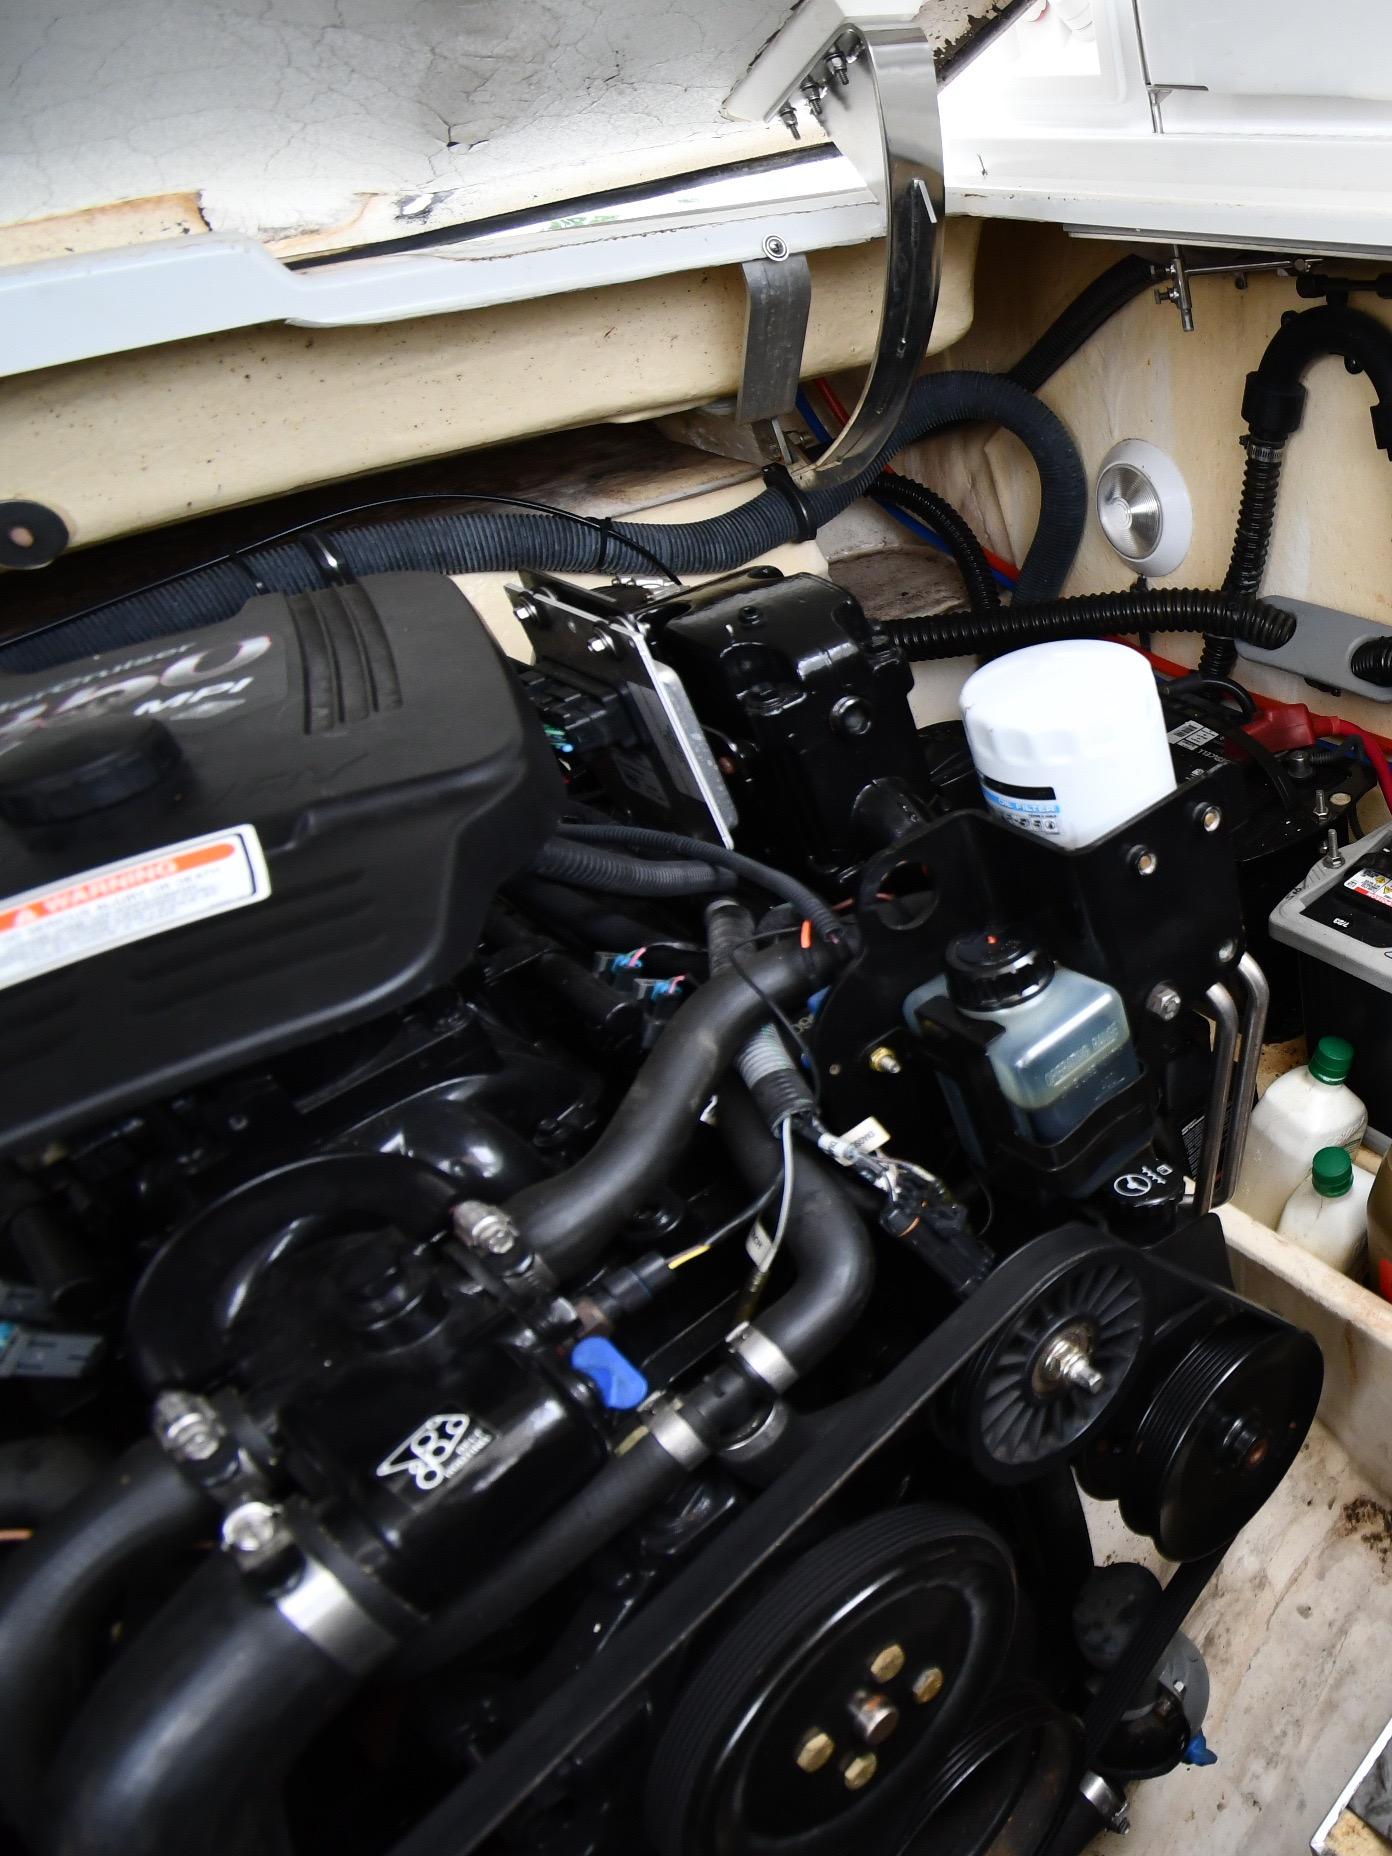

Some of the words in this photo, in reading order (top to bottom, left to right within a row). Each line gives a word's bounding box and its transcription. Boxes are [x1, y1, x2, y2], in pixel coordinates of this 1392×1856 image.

[998, 798, 1021, 811] OIL
[1022, 801, 1058, 814] FILTER
[47, 861, 178, 909] WARNING
